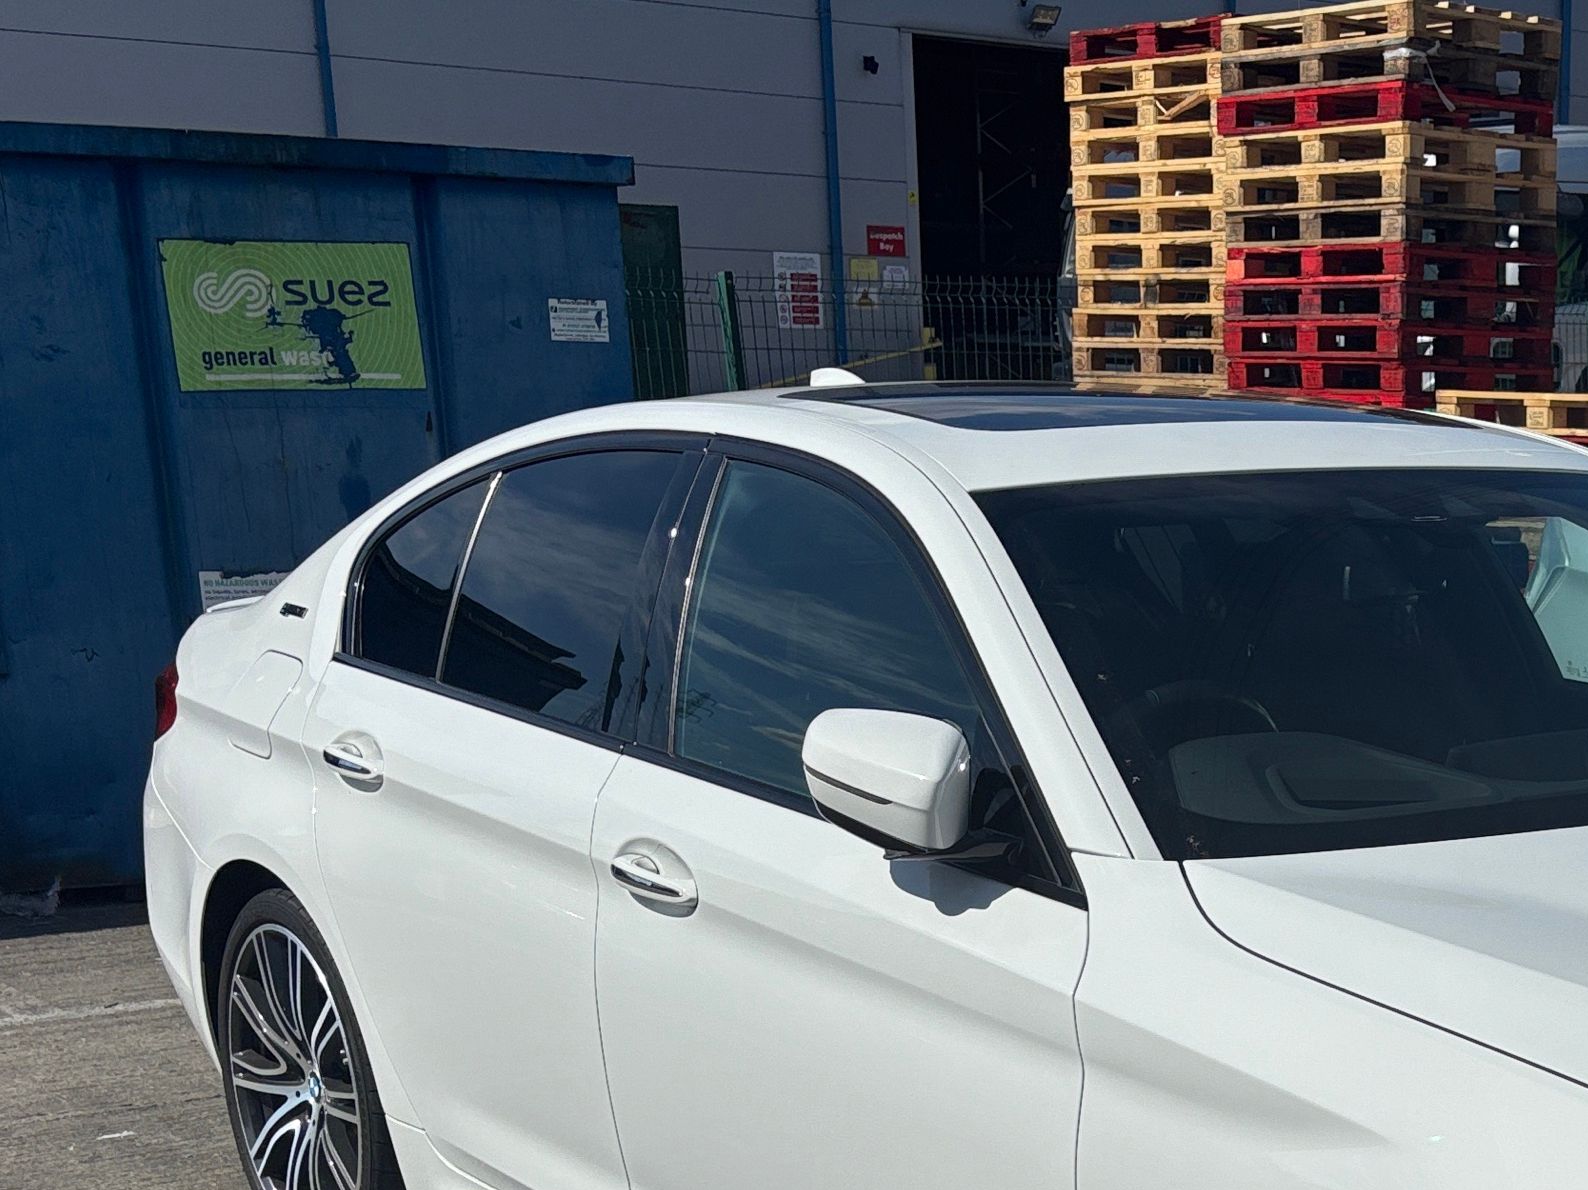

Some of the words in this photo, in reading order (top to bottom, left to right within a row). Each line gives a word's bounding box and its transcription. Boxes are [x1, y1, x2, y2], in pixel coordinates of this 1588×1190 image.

[282, 279, 391, 307] suez
[202, 347, 278, 371] general
[281, 351, 335, 367] was
